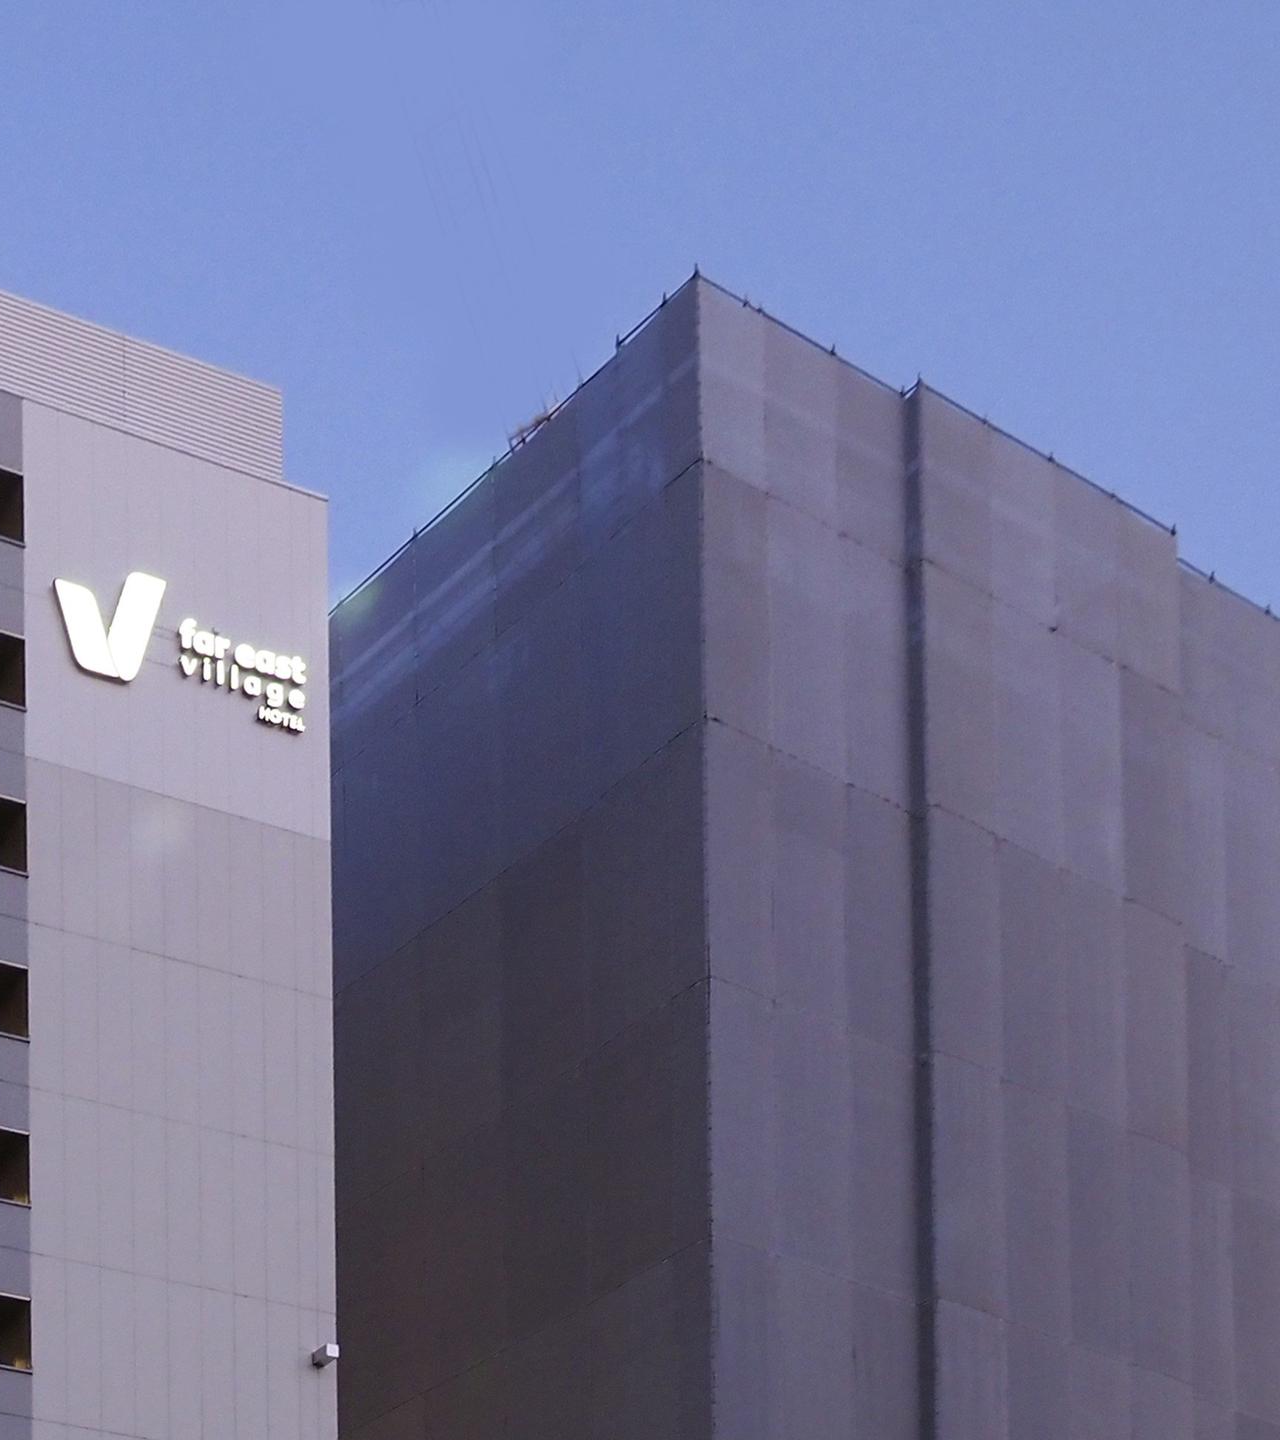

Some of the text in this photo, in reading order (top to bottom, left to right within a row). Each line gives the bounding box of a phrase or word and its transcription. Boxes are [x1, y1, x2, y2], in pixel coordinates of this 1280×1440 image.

[178, 618, 307, 684] far east
[178, 655, 306, 709] village
[257, 706, 306, 733] HOTEL
